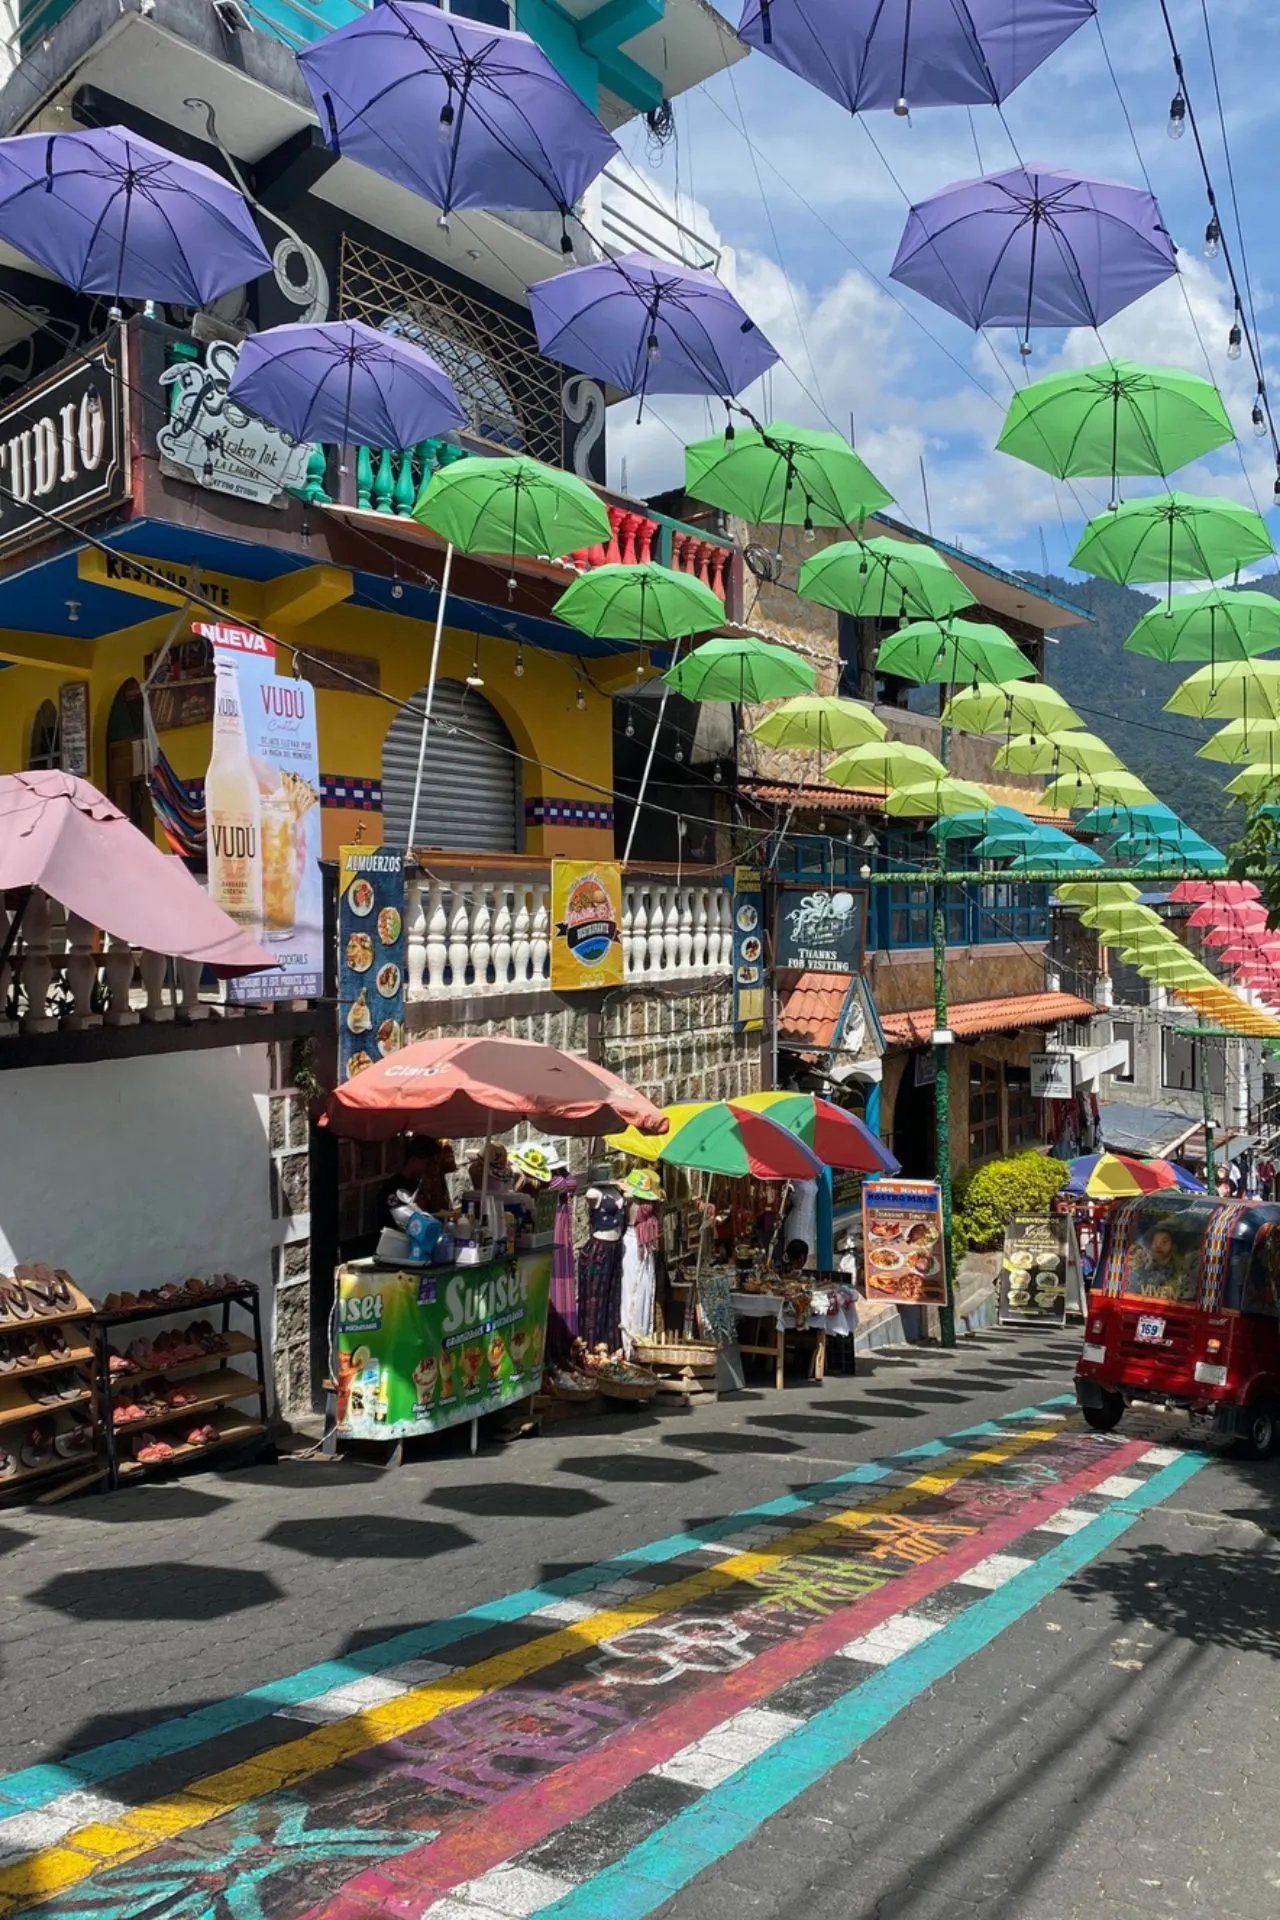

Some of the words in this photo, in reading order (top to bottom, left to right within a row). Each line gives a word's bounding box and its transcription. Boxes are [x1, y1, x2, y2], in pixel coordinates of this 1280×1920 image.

[214, 459, 226, 471] LA
[200, 624, 268, 653] NUEVA
[260, 684, 305, 720] VUDÚ
[211, 823, 256, 859] VUDÚ
[346, 855, 401, 872] ALMUERZOS
[798, 948, 837, 960] THANKS
[788, 958, 805, 969] FOR
[807, 959, 849, 972] VISITING
[384, 1064, 437, 1077] Claro
[442, 1267, 528, 1332] Sunset
[1141, 1323, 1159, 1336] 169
